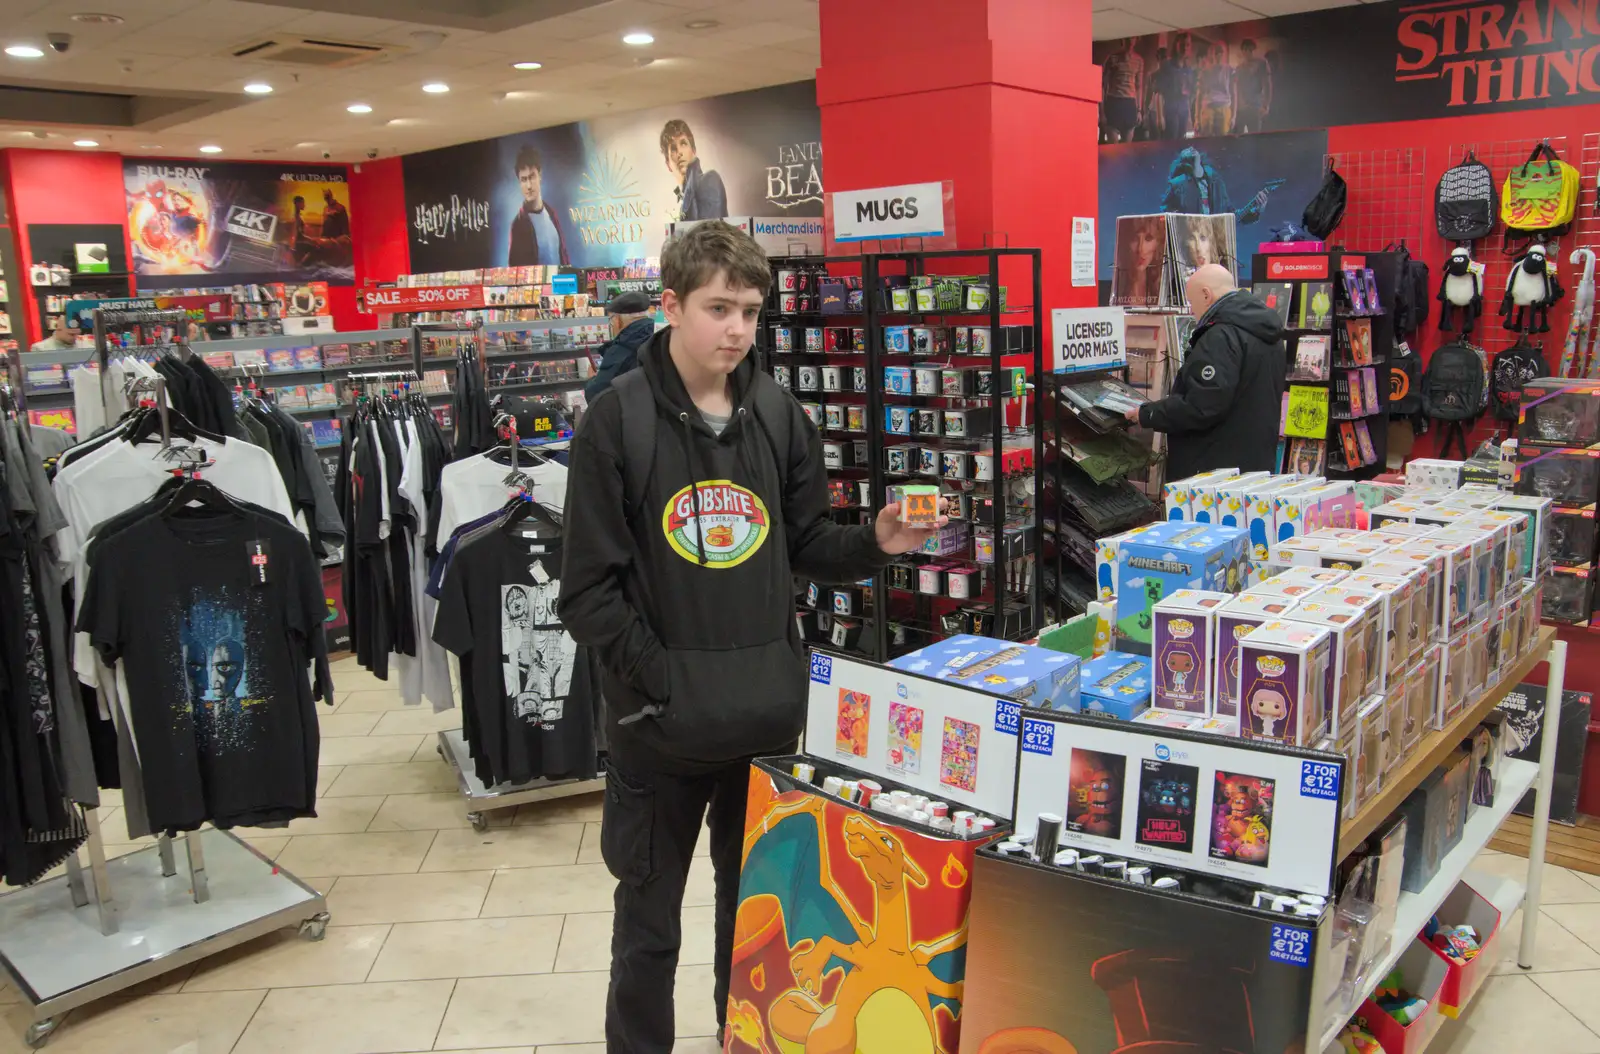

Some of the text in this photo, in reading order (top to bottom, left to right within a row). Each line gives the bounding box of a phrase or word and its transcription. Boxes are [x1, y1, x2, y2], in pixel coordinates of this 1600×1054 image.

[137, 165, 206, 181] BLU-RAY
[280, 173, 344, 183] 4K ULTRA HD
[414, 194, 490, 239] Harry Potter
[568, 199, 652, 224] WIZARDING
[856, 196, 918, 223] MUGS
[233, 210, 269, 231] 4K
[580, 223, 644, 247] WORLD
[587, 271, 610, 281] MUSIC
[619, 281, 660, 292] BEST OF
[99, 299, 155, 310] MUST HAVE
[366, 291, 402, 306] SALE
[418, 289, 445, 303] 50%
[446, 288, 470, 301] OFF
[1066, 321, 1113, 341] LICENSED
[1062, 340, 1119, 361] DOOR MATS
[1127, 555, 1192, 577] MINECRAFT
[812, 655, 831, 667] 2 FOR
[812, 664, 829, 676] €12
[1503, 696, 1527, 705] AVID
[997, 702, 1020, 715] 2 FOR
[997, 712, 1018, 727] €12
[1025, 722, 1053, 735] 2 FOR
[1025, 732, 1050, 746] €12
[1304, 763, 1337, 778] 2 FOR
[1304, 774, 1333, 789] €12
[1151, 821, 1177, 831] HELP
[1145, 831, 1184, 842] WANTED
[1272, 926, 1309, 943] 2 FOR
[1273, 939, 1305, 955] €12
[1270, 950, 1307, 963] OR €7 EACH
